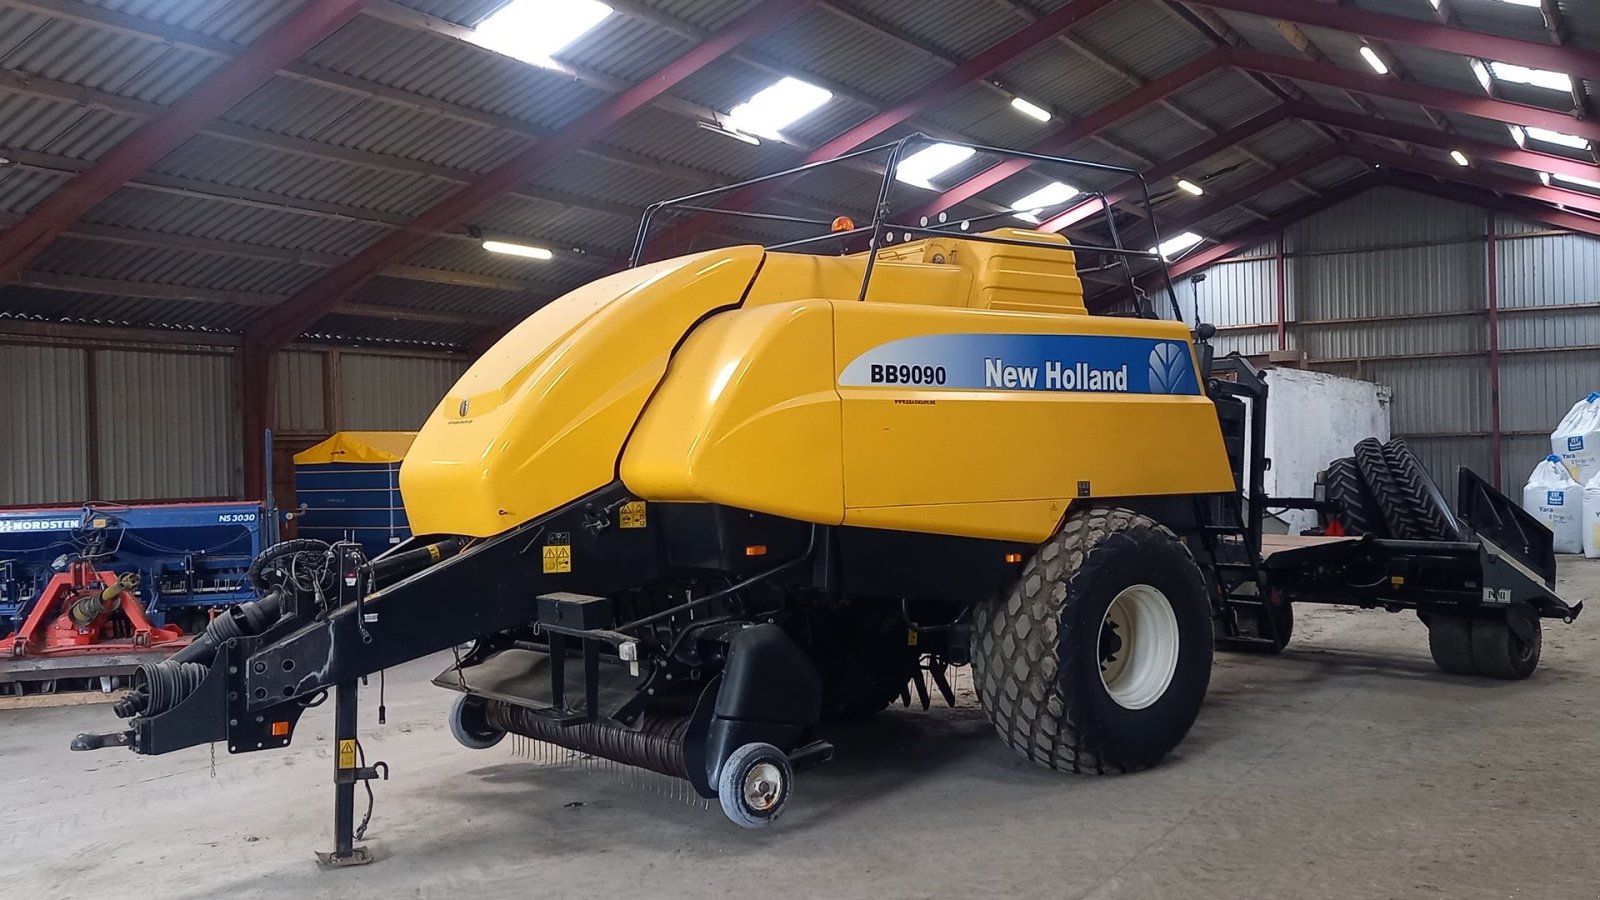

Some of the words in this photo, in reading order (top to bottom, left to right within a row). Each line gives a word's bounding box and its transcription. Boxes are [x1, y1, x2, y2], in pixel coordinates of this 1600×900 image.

[871, 364, 946, 385] BB9090
[985, 359, 1038, 388] New
[1045, 361, 1128, 391] Holland
[13, 520, 79, 530] NORDSTEN
